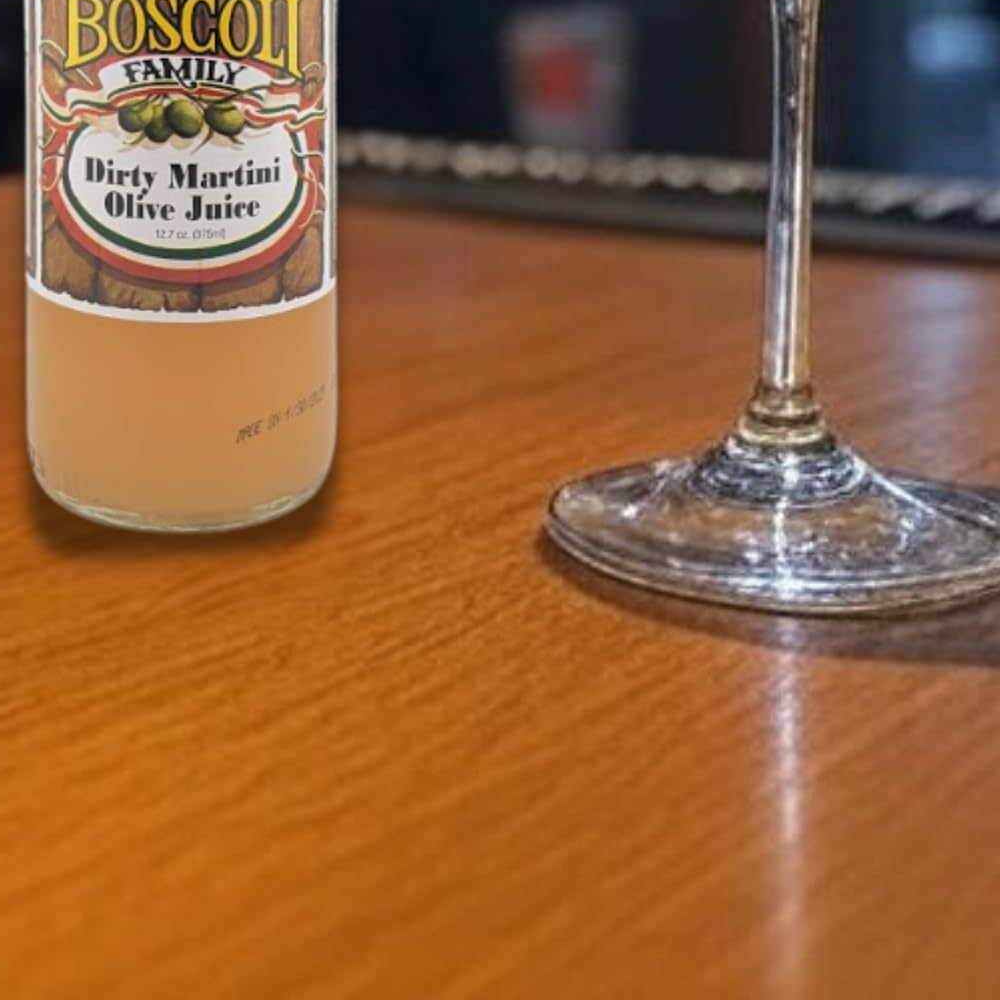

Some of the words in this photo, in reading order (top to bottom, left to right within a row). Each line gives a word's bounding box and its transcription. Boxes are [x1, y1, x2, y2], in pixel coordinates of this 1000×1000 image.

[122, 57, 247, 88] FAMILY
[85, 156, 157, 195] Dirty
[168, 156, 280, 189] Martini
[104, 190, 175, 221] Olive
[185, 194, 260, 221] Juice
[155, 228, 174, 239] 12.7
[176, 231, 190, 239] oz.
